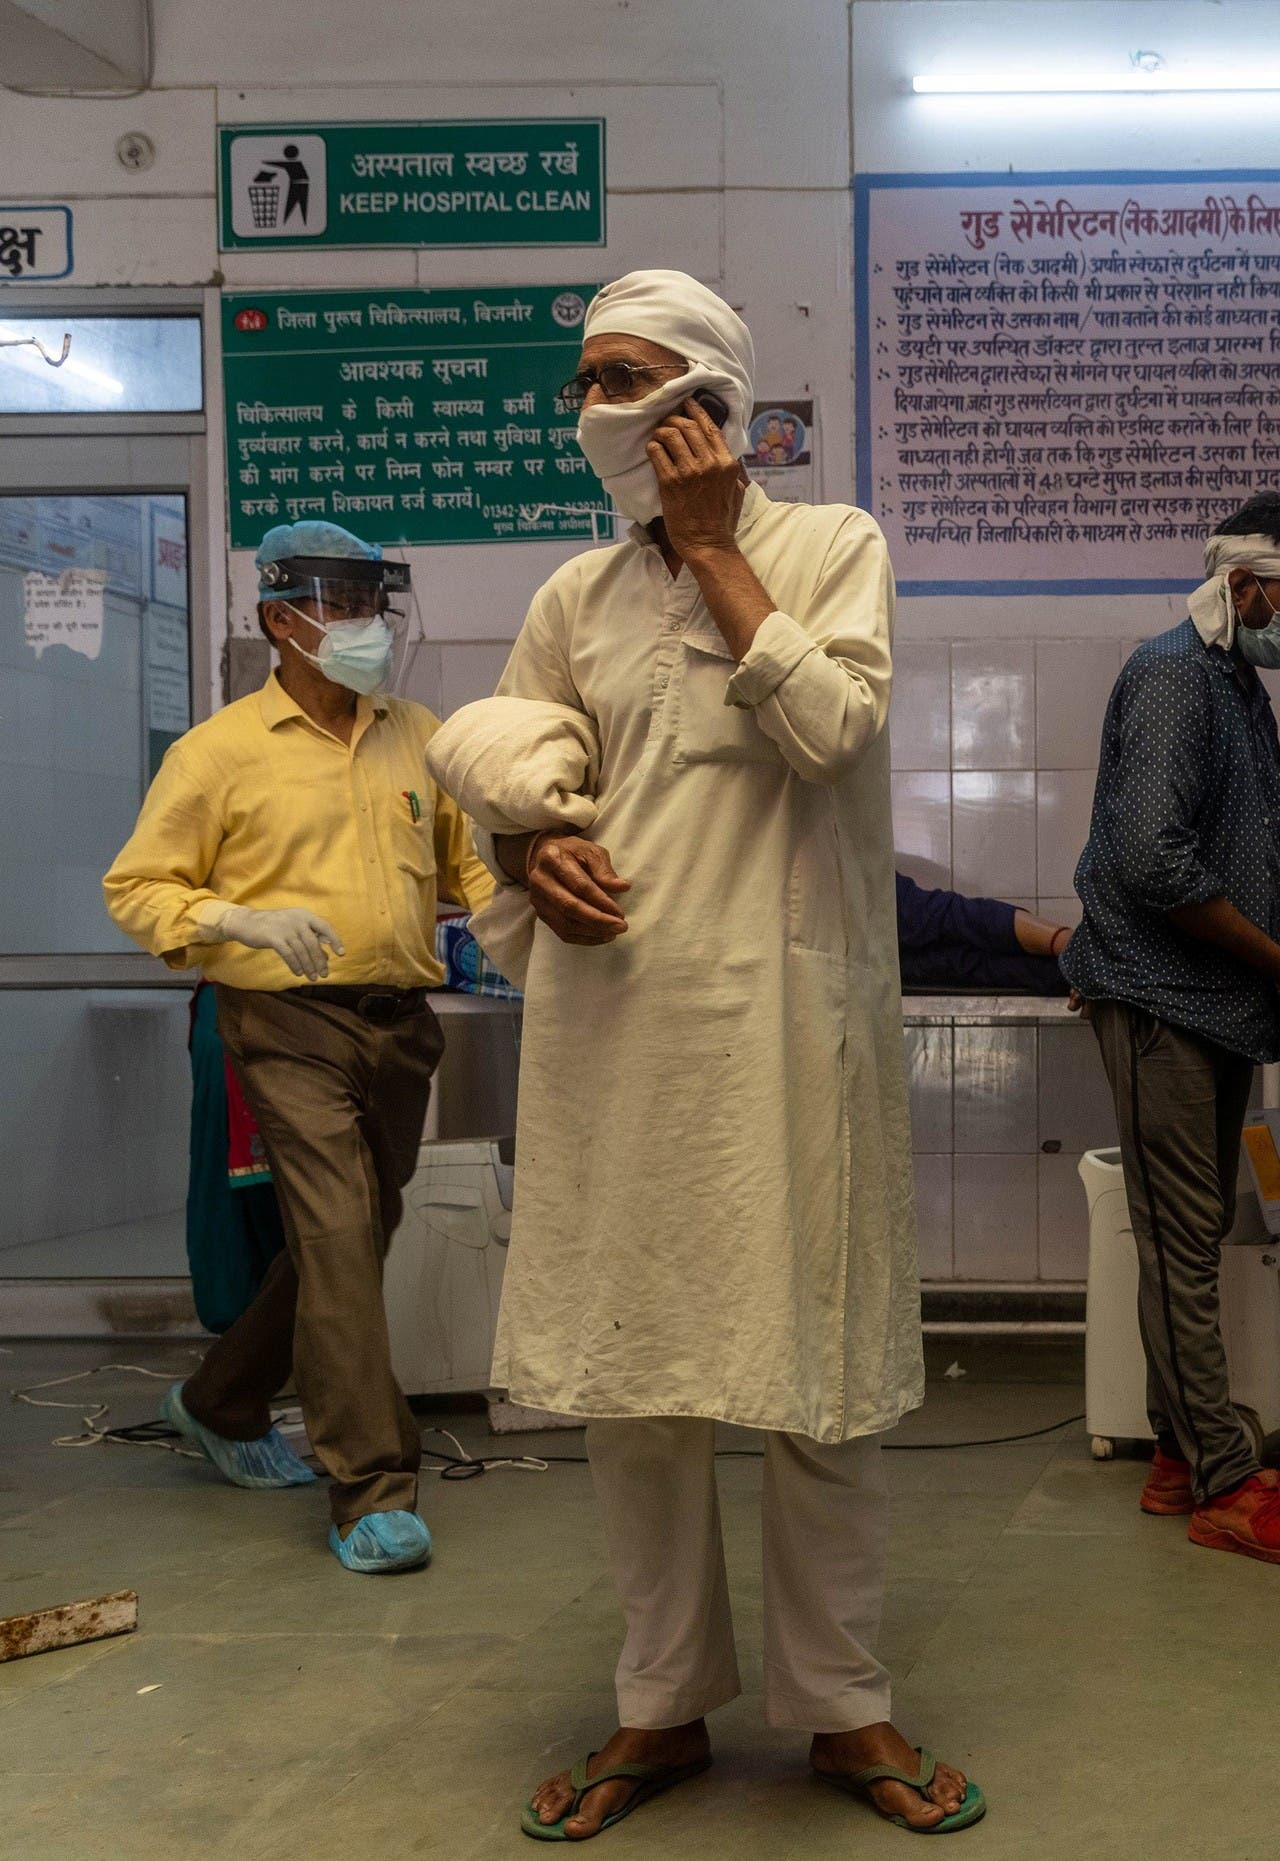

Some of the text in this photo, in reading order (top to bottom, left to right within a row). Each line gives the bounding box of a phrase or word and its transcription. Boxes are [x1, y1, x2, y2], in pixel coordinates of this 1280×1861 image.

[351, 142, 579, 178] अस्पताल स्वच्छ रखें
[340, 191, 591, 213] KEEP HOSPITAL CLEAN
[960, 211, 1003, 250] गुड
[1009, 198, 1119, 244] सेमेरिटन
[1225, 197, 1246, 236] के
[896, 260, 920, 281] गुड
[945, 280, 973, 304] वाले
[974, 280, 1016, 304] व्यक्ति
[1018, 280, 1038, 303] को
[1041, 277, 1079, 303] किसी
[1104, 283, 1143, 302] प्रकार
[1143, 277, 1159, 302] से
[1162, 276, 1213, 302] परेशान
[276, 306, 316, 330] जिला
[897, 312, 922, 336] गुड
[989, 306, 1006, 330] से
[1052, 312, 1080, 330] नाम
[1093, 310, 1121, 328] पता
[1161, 302, 1184, 327] की
[1183, 304, 1213, 326] कोई
[946, 340, 967, 358] पर
[1125, 338, 1164, 359] तुरन्त
[340, 357, 488, 385] आवश्यक सूचना
[237, 400, 323, 425] चिकित्सालय
[342, 398, 357, 420] के
[376, 395, 414, 419] किसी
[432, 399, 485, 417] स्वास्थ्य
[503, 391, 536, 416] कर्मी
[308, 429, 351, 453] करने,
[356, 427, 389, 450] कार्य
[395, 432, 407, 449] न
[414, 426, 450, 449] करने
[457, 430, 487, 447] तथा
[493, 422, 541, 452] सुविधा
[898, 448, 950, 468] बाध्यता
[1045, 446, 1073, 468] तक
[1075, 440, 1096, 464] कि
[1098, 447, 1123, 469] गुड
[1198, 446, 1247, 467] उसका
[239, 452, 588, 486] की मांग करने पर निम्न फोन नम्बर पर फोन
[898, 468, 952, 493] सरकारी
[1022, 466, 1037, 491] में
[1184, 465, 1204, 489] की
[240, 493, 279, 516] करके
[285, 496, 325, 520] तुरन्त
[332, 490, 394, 512] शिकायत
[401, 487, 425, 511] दर्ज
[902, 501, 925, 521] गुड
[991, 493, 1010, 516] को
